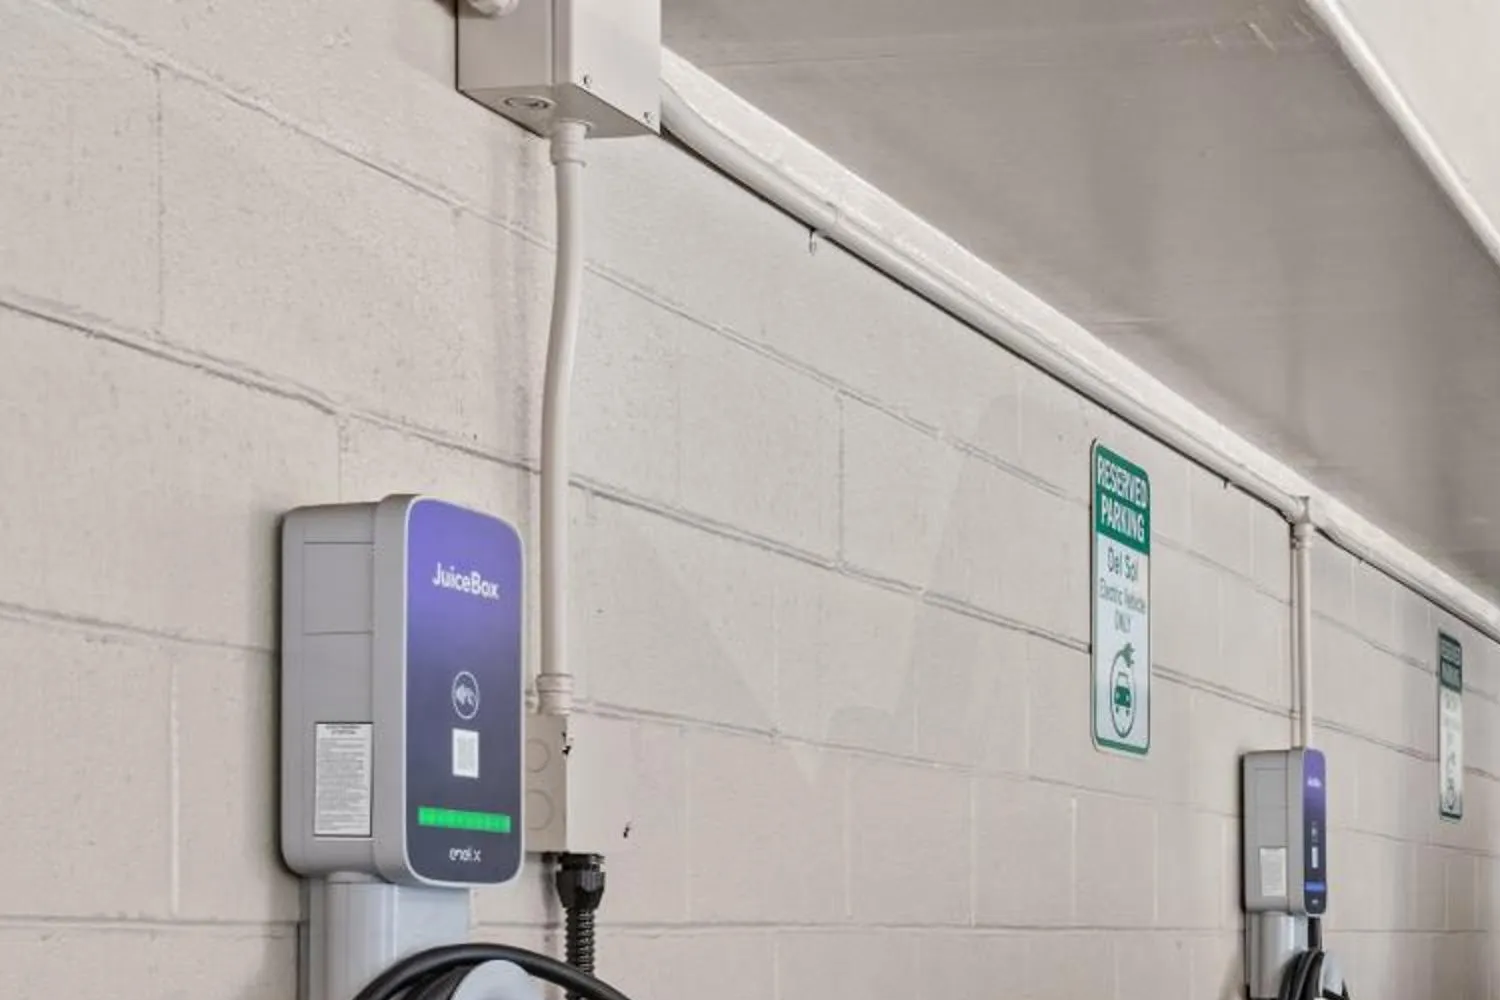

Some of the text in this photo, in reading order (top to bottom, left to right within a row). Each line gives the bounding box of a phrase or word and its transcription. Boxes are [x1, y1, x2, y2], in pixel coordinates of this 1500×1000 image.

[1097, 454, 1148, 508] RESERVED
[1101, 494, 1145, 543] PARKING
[432, 561, 499, 600] JuiceBox
